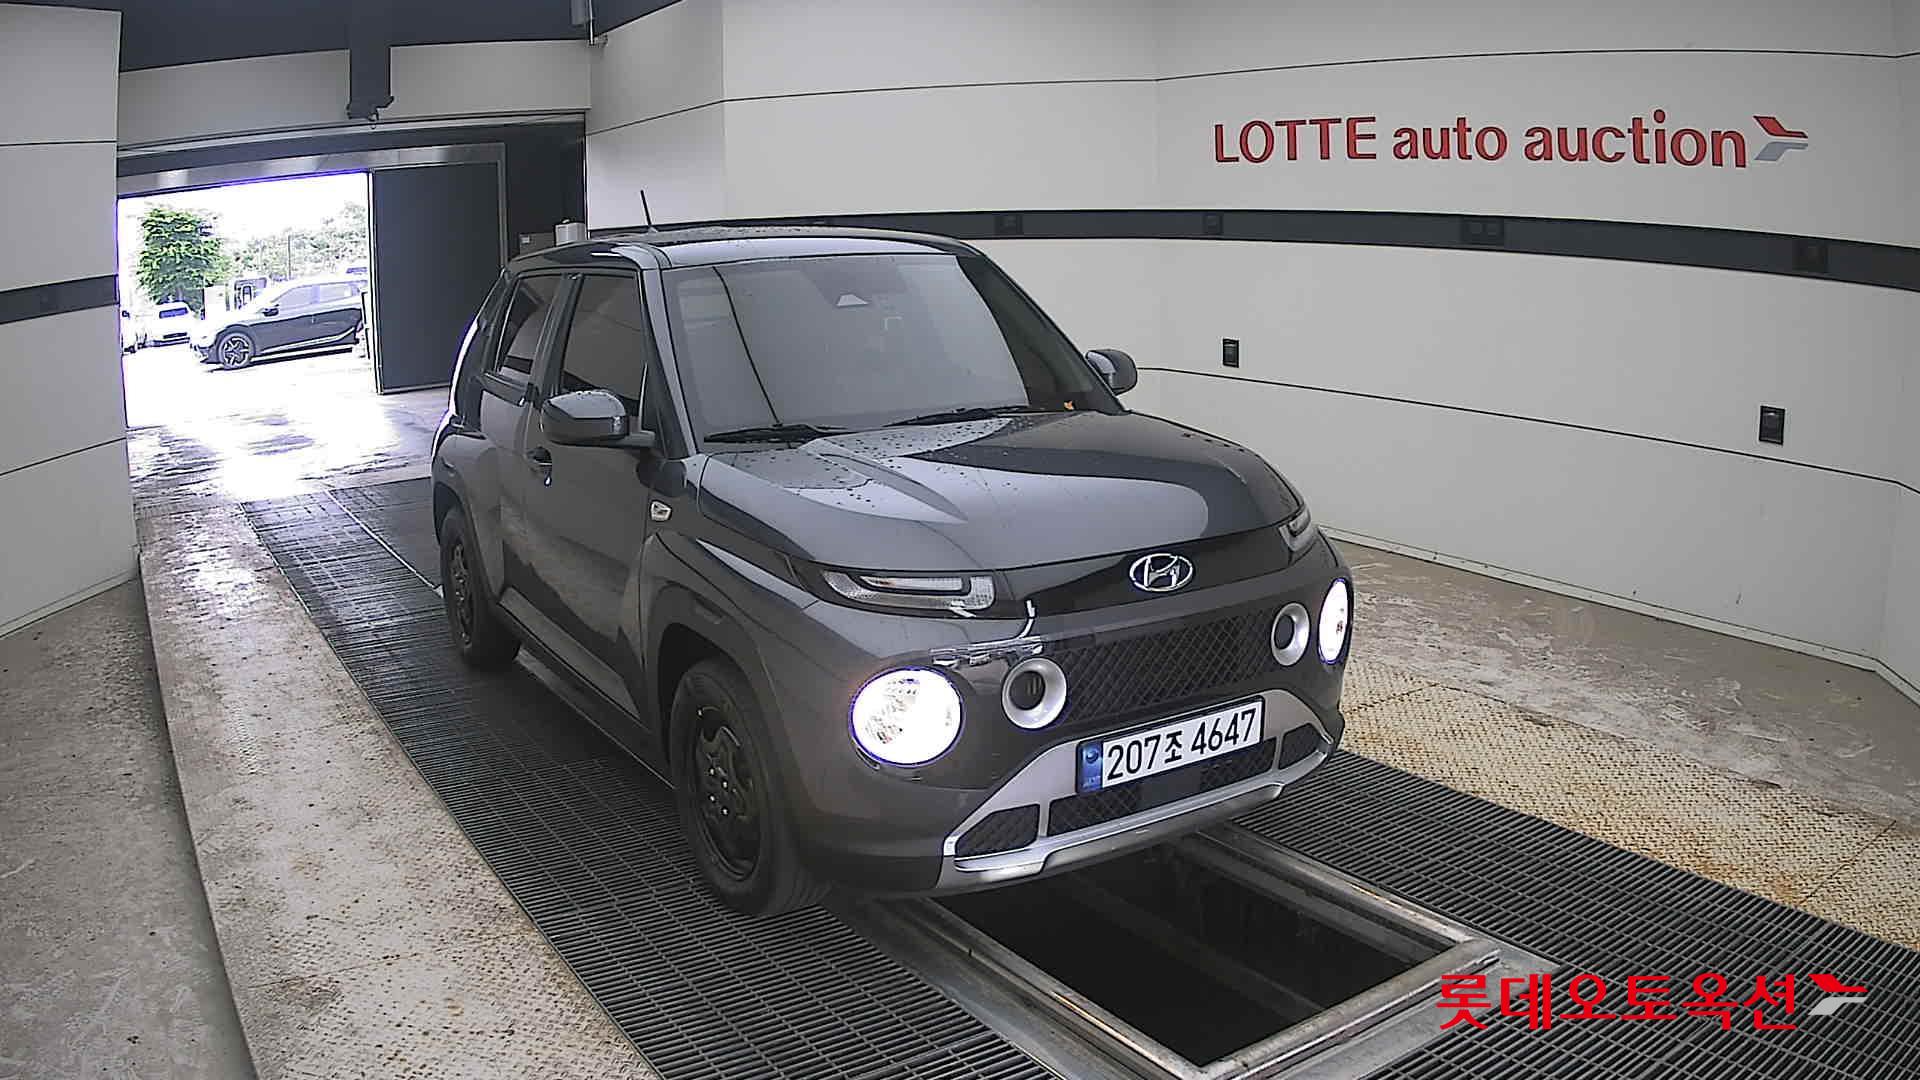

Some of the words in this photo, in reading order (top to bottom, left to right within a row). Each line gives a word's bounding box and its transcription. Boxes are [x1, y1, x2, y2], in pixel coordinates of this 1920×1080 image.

[1213, 116, 1377, 163] LOTTE
[1392, 116, 1508, 161] auto
[1523, 110, 1747, 168] auction
[1106, 730, 1183, 780] 207조
[1191, 708, 1257, 754] 4647
